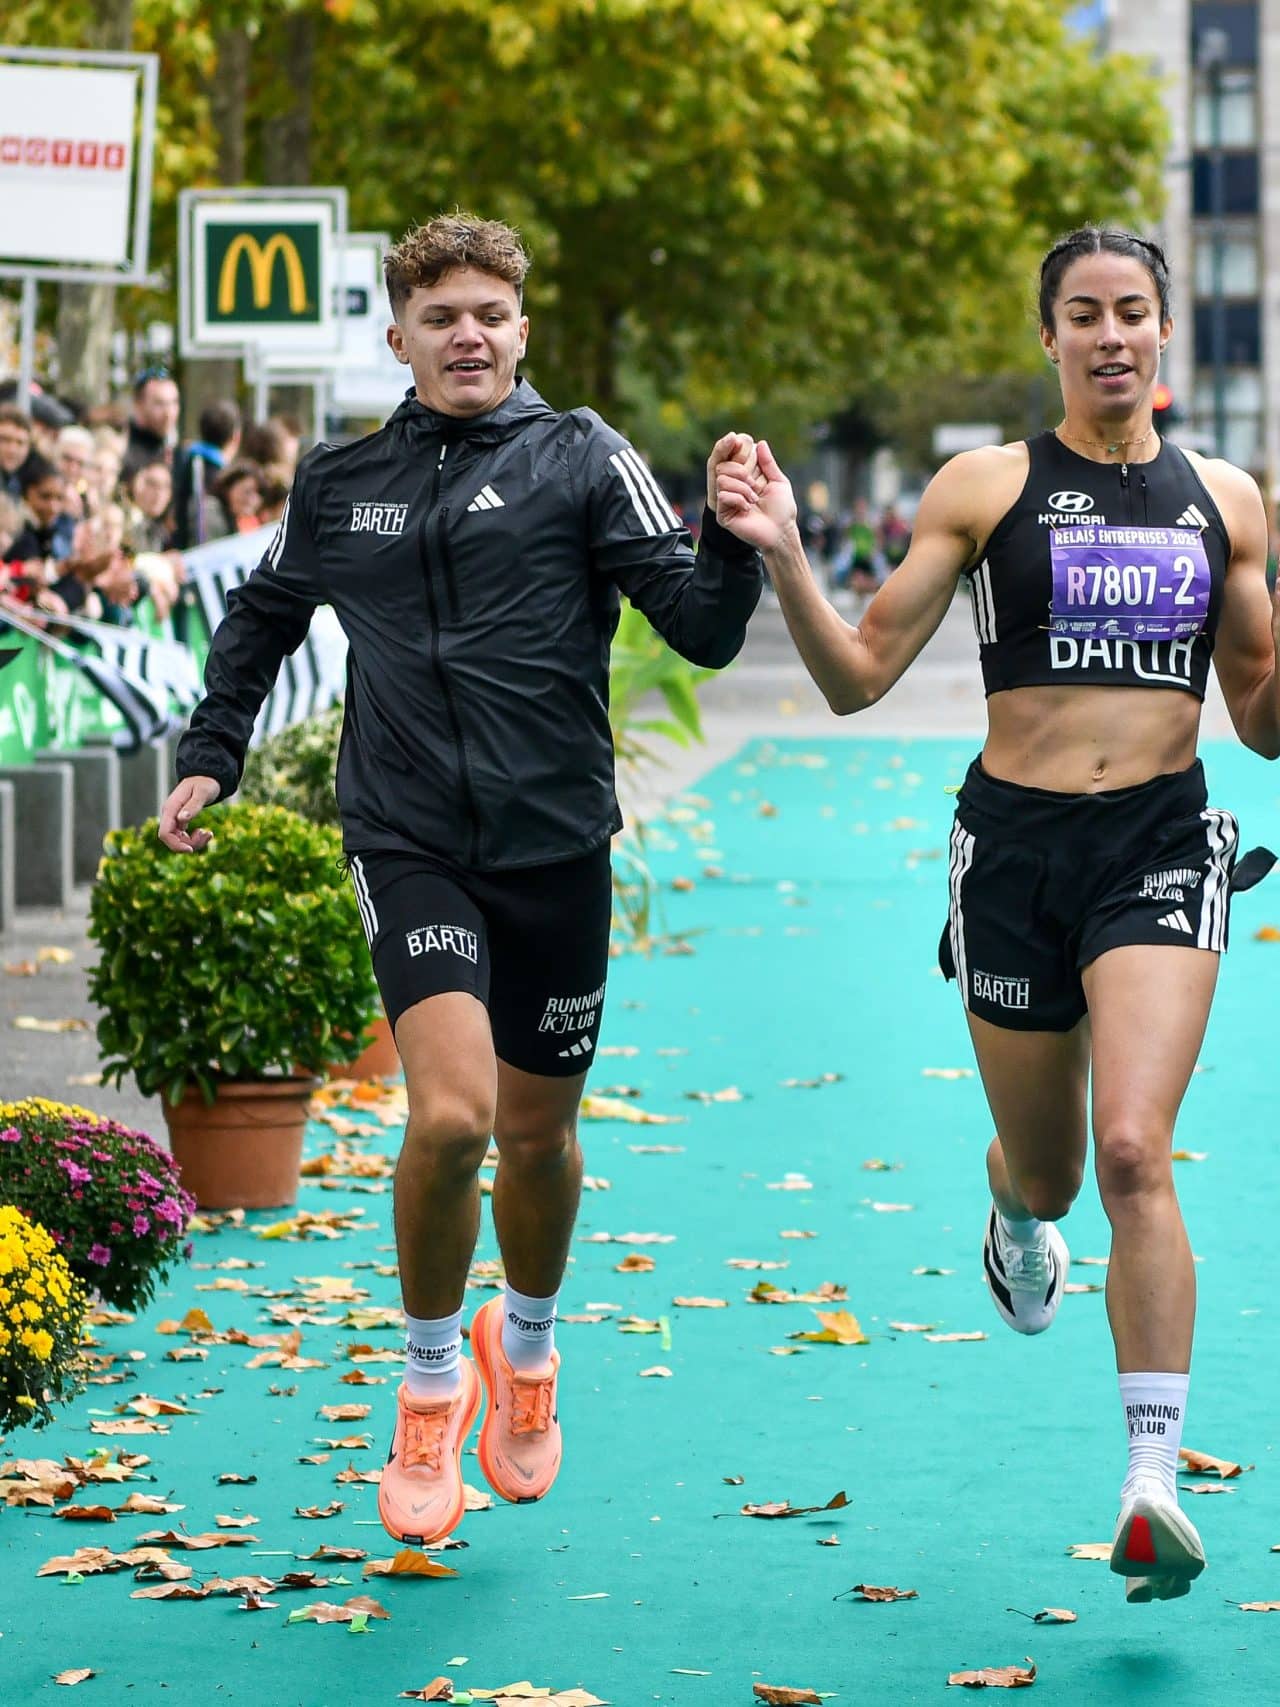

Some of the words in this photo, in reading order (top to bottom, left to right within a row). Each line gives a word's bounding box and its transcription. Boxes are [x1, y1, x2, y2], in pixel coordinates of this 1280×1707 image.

[350, 507, 408, 535] BARTH
[1038, 513, 1105, 525] HYUNDAI
[1055, 529, 1096, 545] RELAIS
[1099, 530, 1169, 545] ENTREPRISES
[1172, 533, 1198, 546] 2025
[1067, 556, 1196, 606] R7807-2
[1143, 868, 1202, 889] RUNNING
[407, 929, 478, 964] BARTH
[546, 982, 605, 1014] RUNNIN
[973, 973, 1029, 1009] BARTH
[1126, 1404, 1180, 1421] RUNNING
